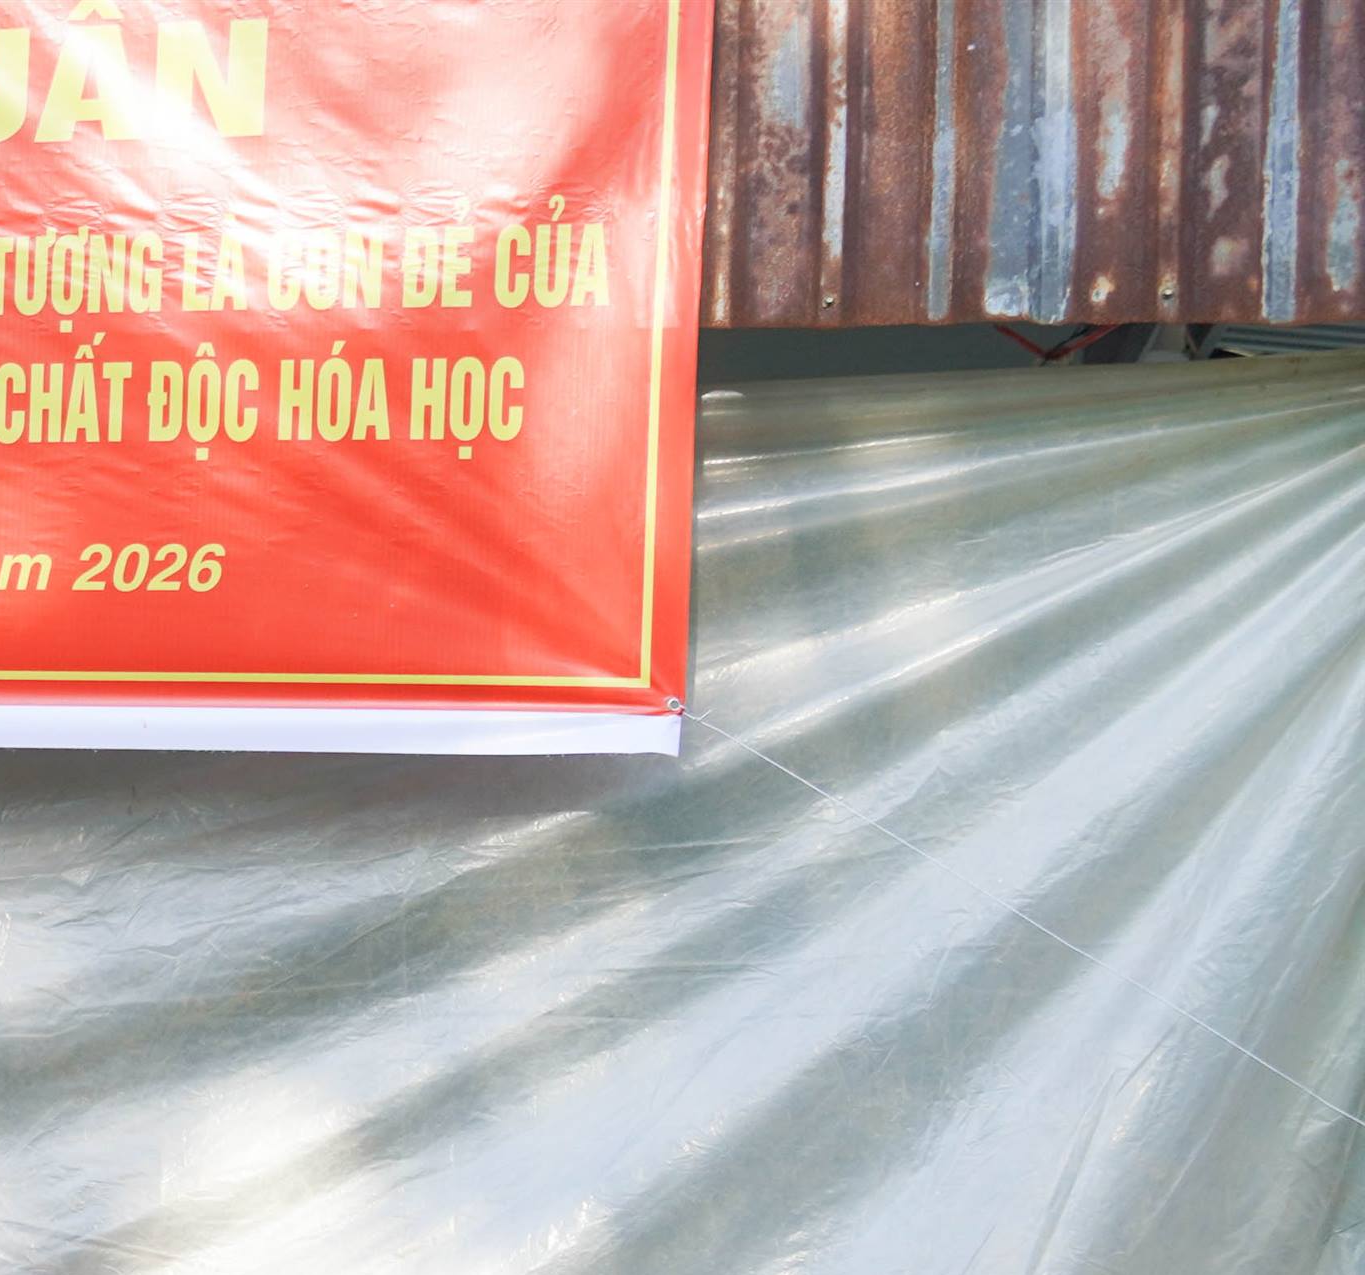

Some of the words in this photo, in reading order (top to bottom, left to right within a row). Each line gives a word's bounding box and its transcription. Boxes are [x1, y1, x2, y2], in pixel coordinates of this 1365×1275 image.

[181, 213, 247, 311] LÀ
[267, 228, 383, 312] CON
[401, 203, 474, 308] ĐẺ
[495, 195, 608, 308] CỦA
[148, 353, 259, 460] ĐỘC
[278, 340, 390, 441] HÓA
[410, 356, 524, 459] HỌC
[72, 544, 225, 591] 2026
